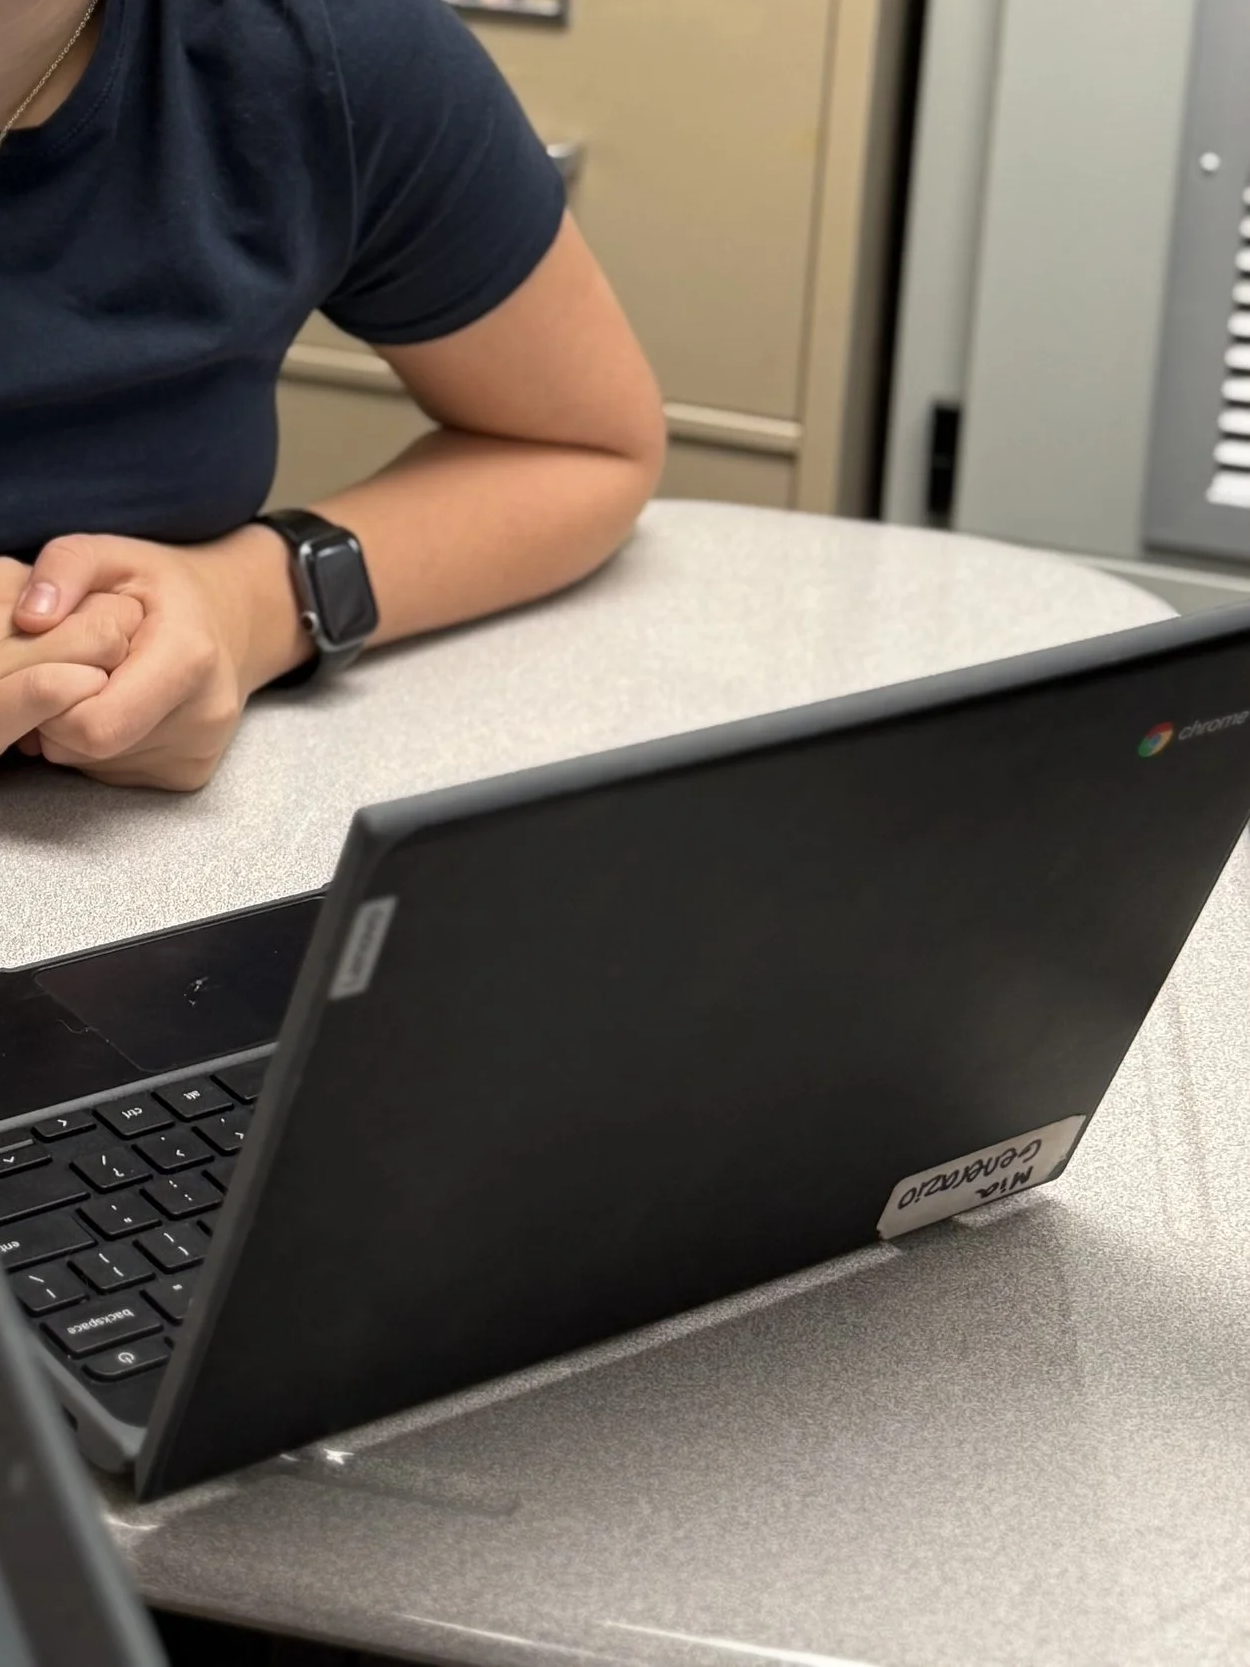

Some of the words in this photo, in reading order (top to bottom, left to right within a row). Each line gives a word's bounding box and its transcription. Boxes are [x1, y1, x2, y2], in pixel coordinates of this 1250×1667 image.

[1178, 710, 1250, 740] chrome
[183, 1090, 201, 1100] alt
[121, 1107, 143, 1119] ctrl
[897, 1138, 1042, 1210] Generazio
[975, 1165, 1034, 1198] Mia
[66, 1308, 135, 1335] backspace
